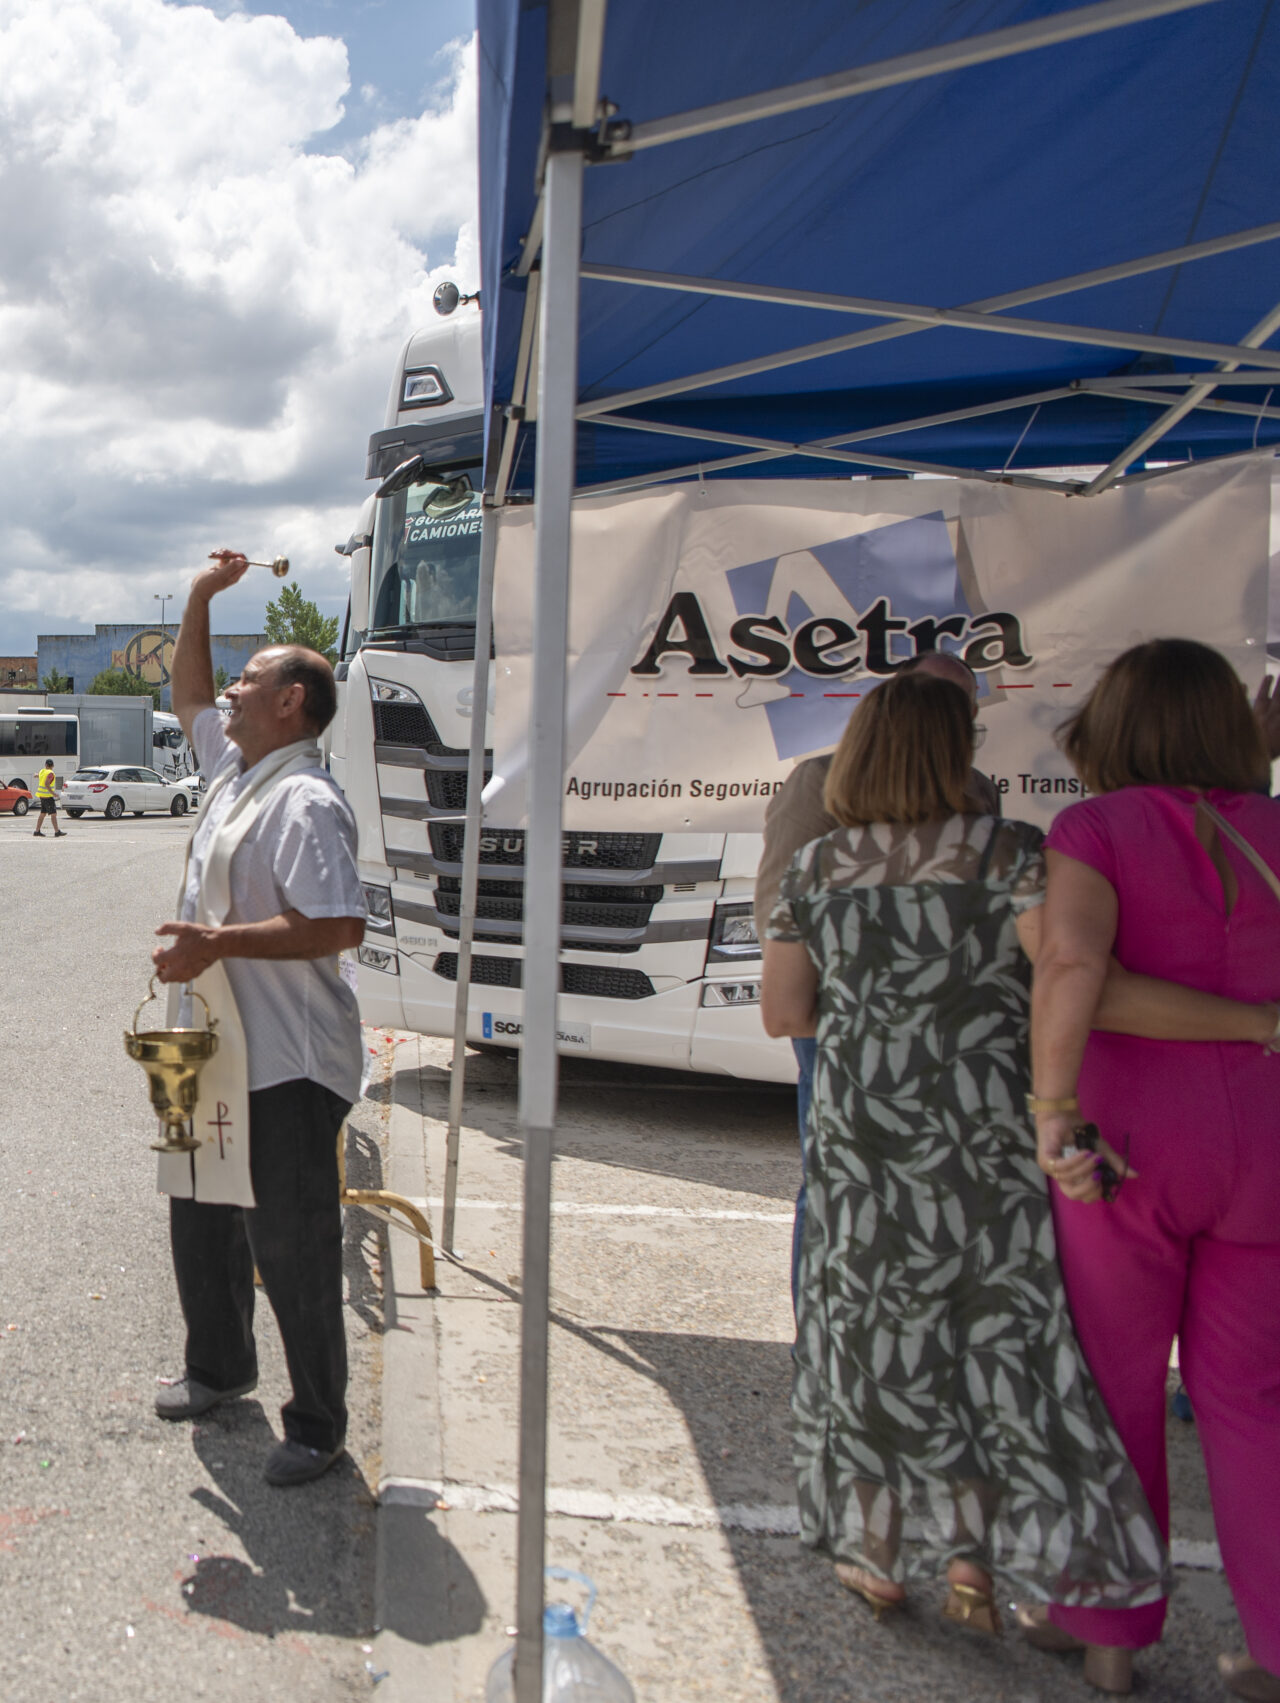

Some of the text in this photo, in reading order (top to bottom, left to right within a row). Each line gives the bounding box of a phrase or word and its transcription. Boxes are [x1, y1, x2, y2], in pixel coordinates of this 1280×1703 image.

[630, 591, 1033, 677] Asetra
[566, 777, 682, 801] Agrupación
[991, 774, 1010, 794] e
[479, 837, 598, 856] SUER
